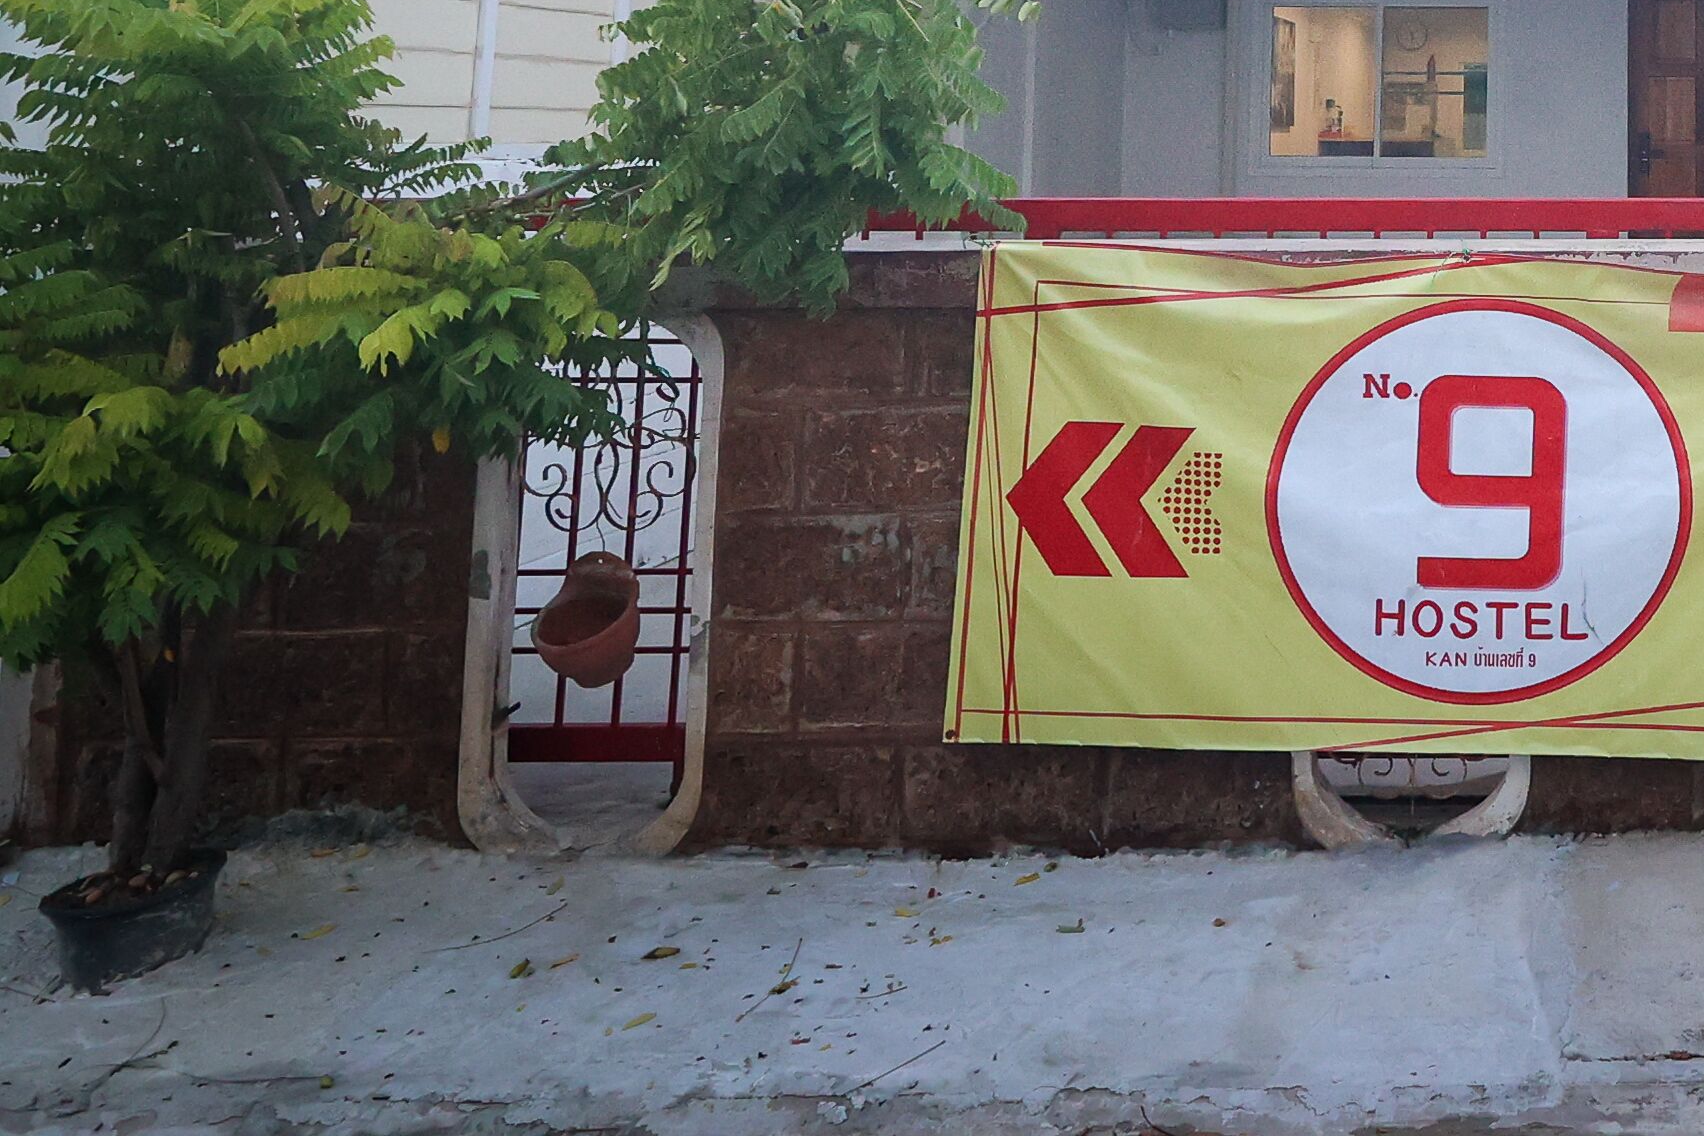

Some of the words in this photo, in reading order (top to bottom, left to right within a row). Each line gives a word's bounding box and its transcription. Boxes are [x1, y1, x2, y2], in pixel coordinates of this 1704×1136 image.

[1416, 375, 1567, 590] 9
[1375, 599, 1588, 640] HOSTEL
[1425, 651, 1467, 666] KAN
[1528, 653, 1536, 668] 9
